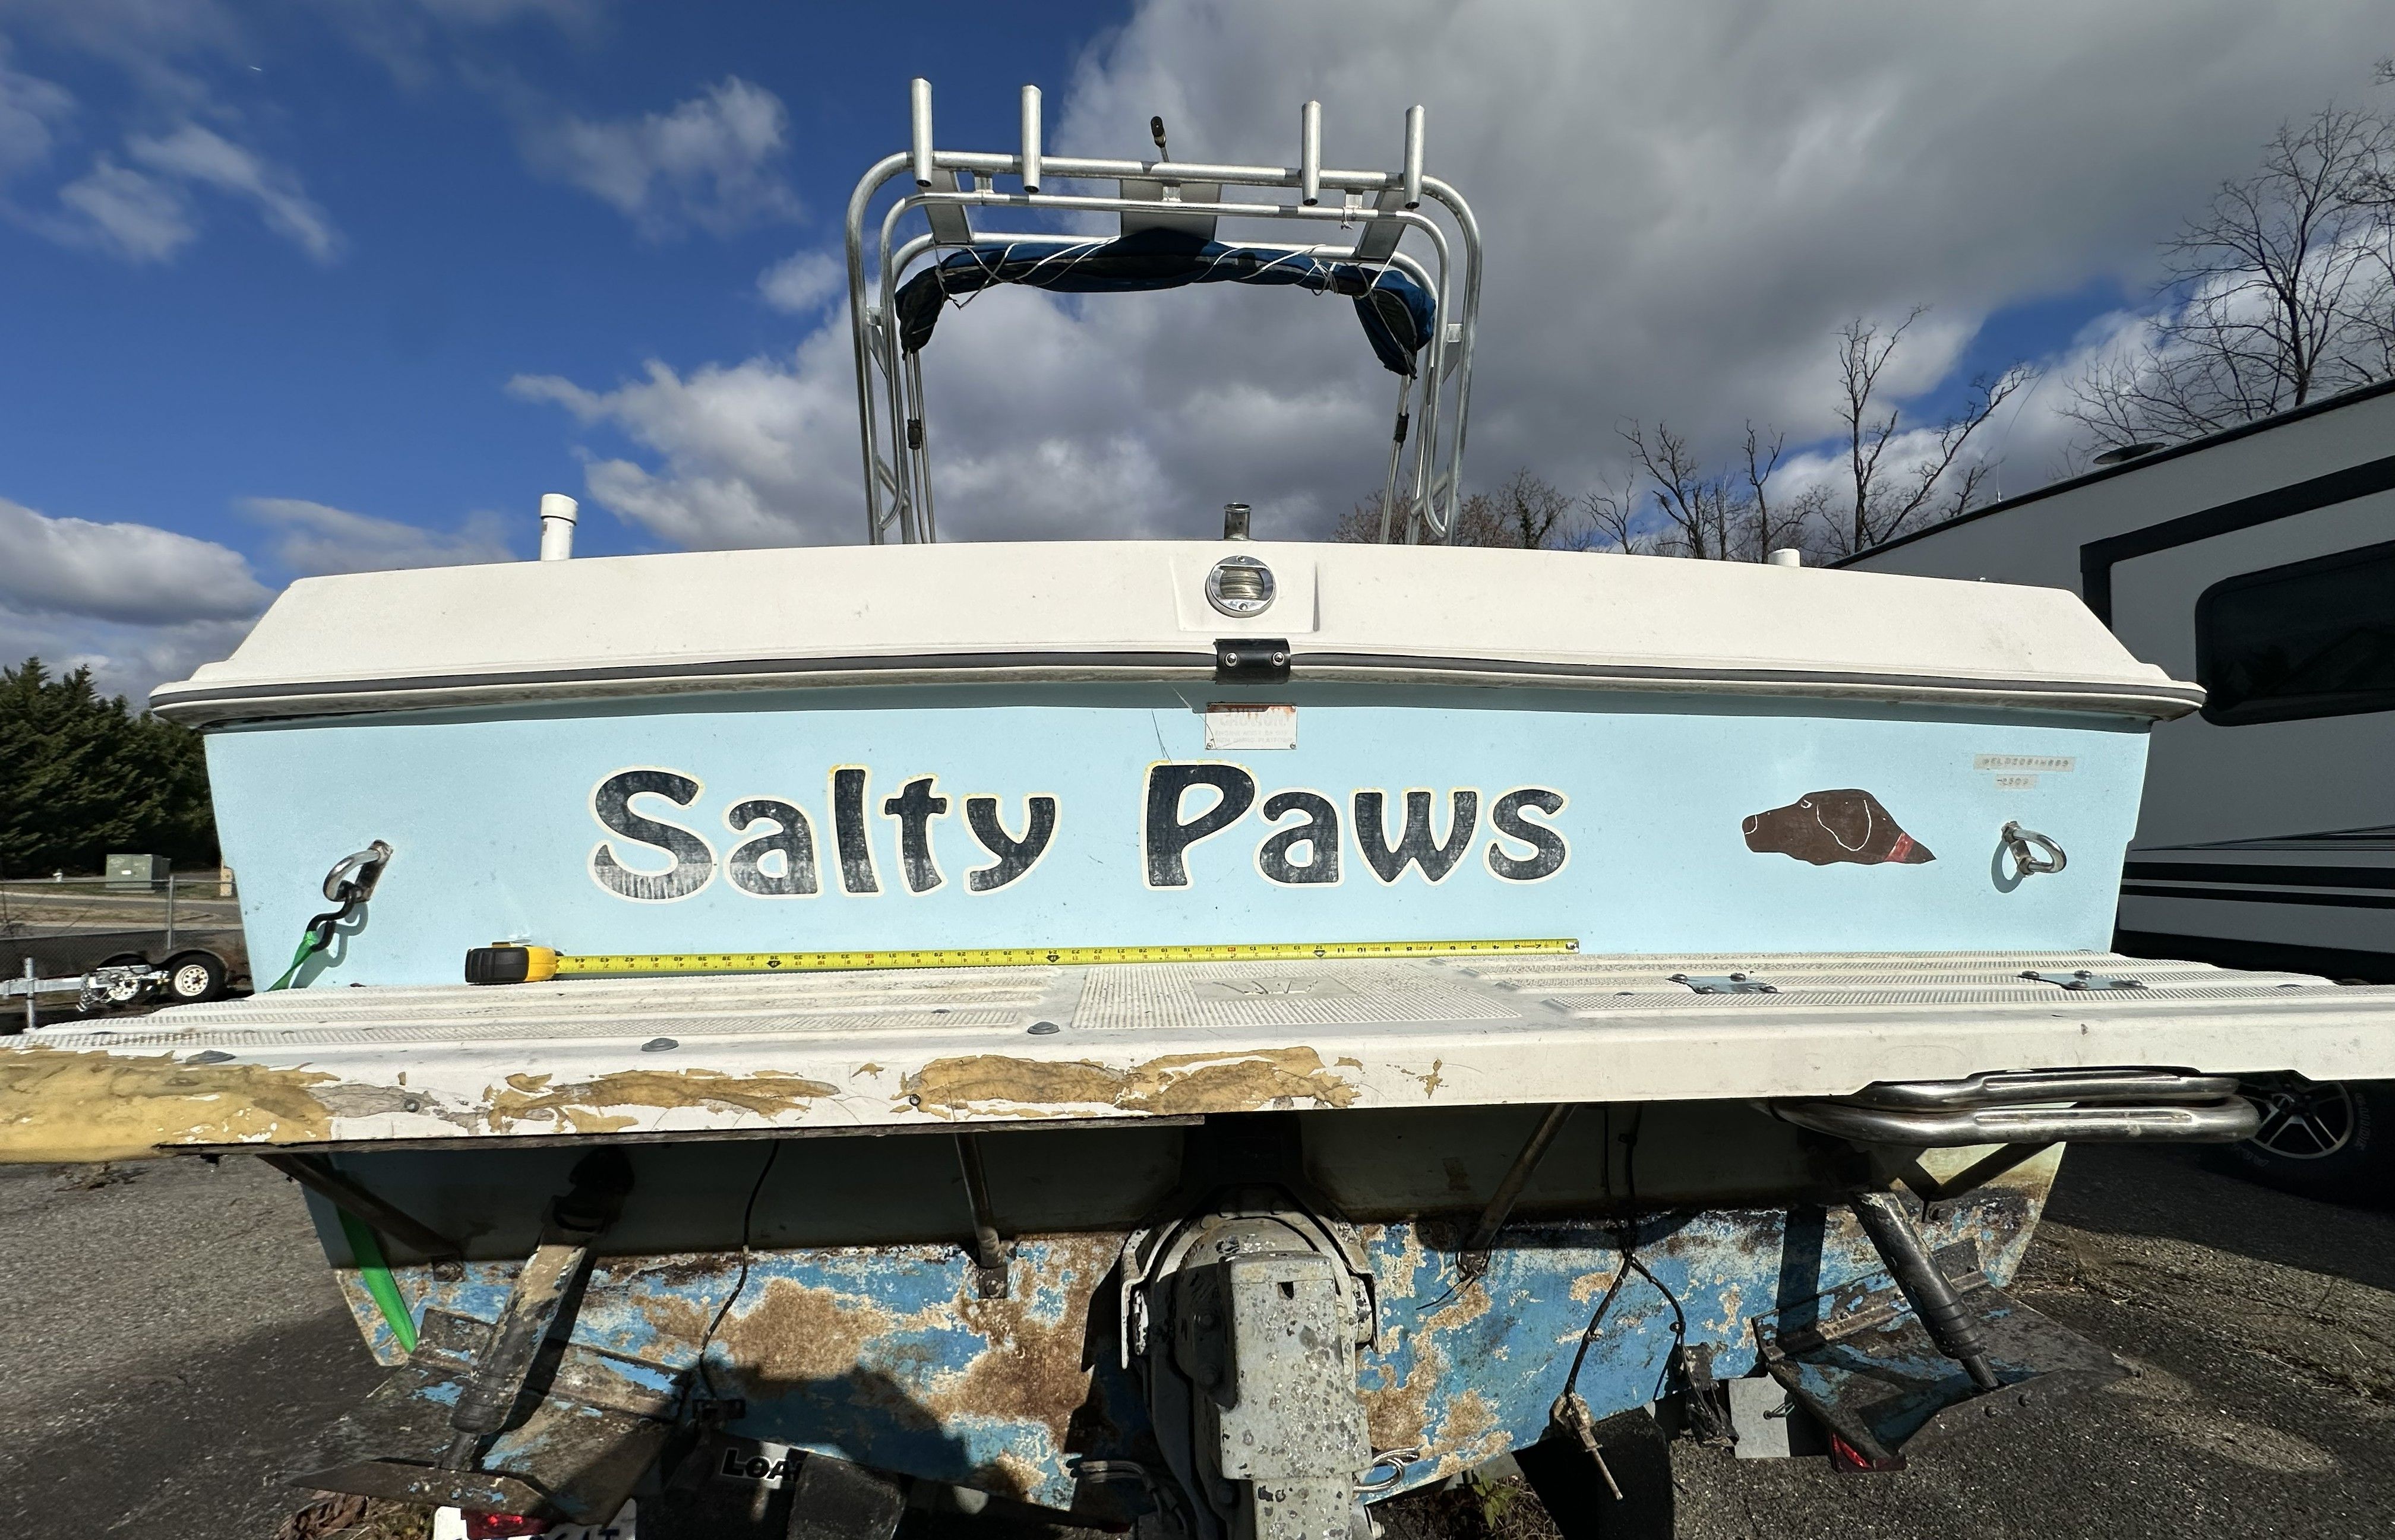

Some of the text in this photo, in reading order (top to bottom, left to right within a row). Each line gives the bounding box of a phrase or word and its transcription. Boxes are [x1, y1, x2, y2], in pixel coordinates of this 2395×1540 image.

[588, 761, 1571, 903] Salty Paws
[720, 1447, 803, 1482] LOA
